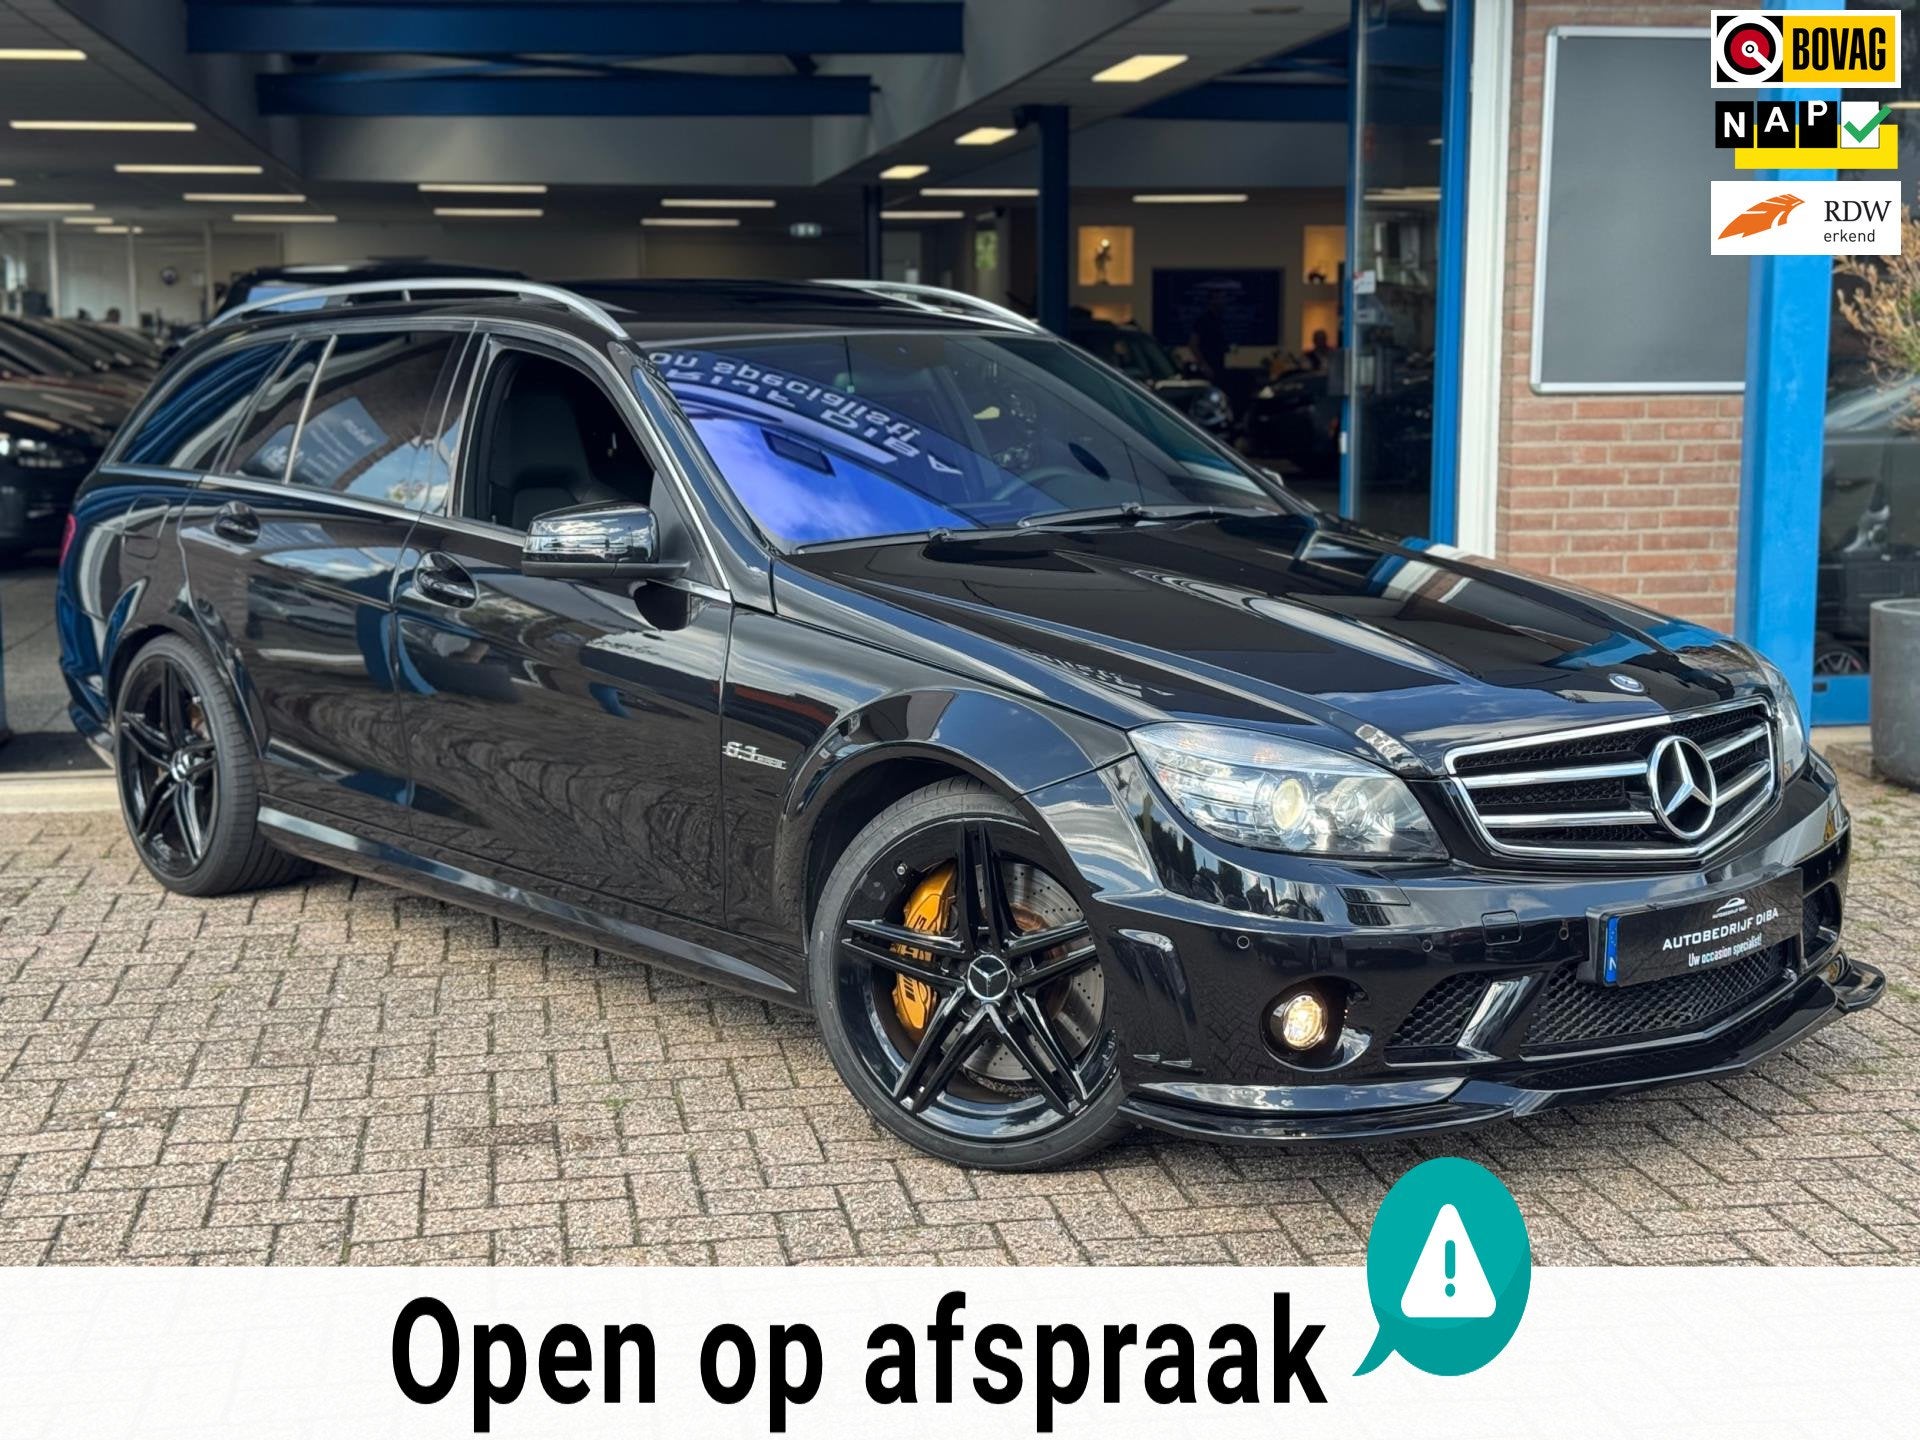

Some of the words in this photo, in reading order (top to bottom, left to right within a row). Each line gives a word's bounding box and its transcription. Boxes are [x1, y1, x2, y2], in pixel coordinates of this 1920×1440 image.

[1662, 917, 1754, 951] AUTOBEDRIJF
[1756, 907, 1779, 926] DIBA
[1688, 952, 1700, 967] Uw
[1701, 946, 1732, 964] occasion
[1733, 932, 1762, 956] specialist!
